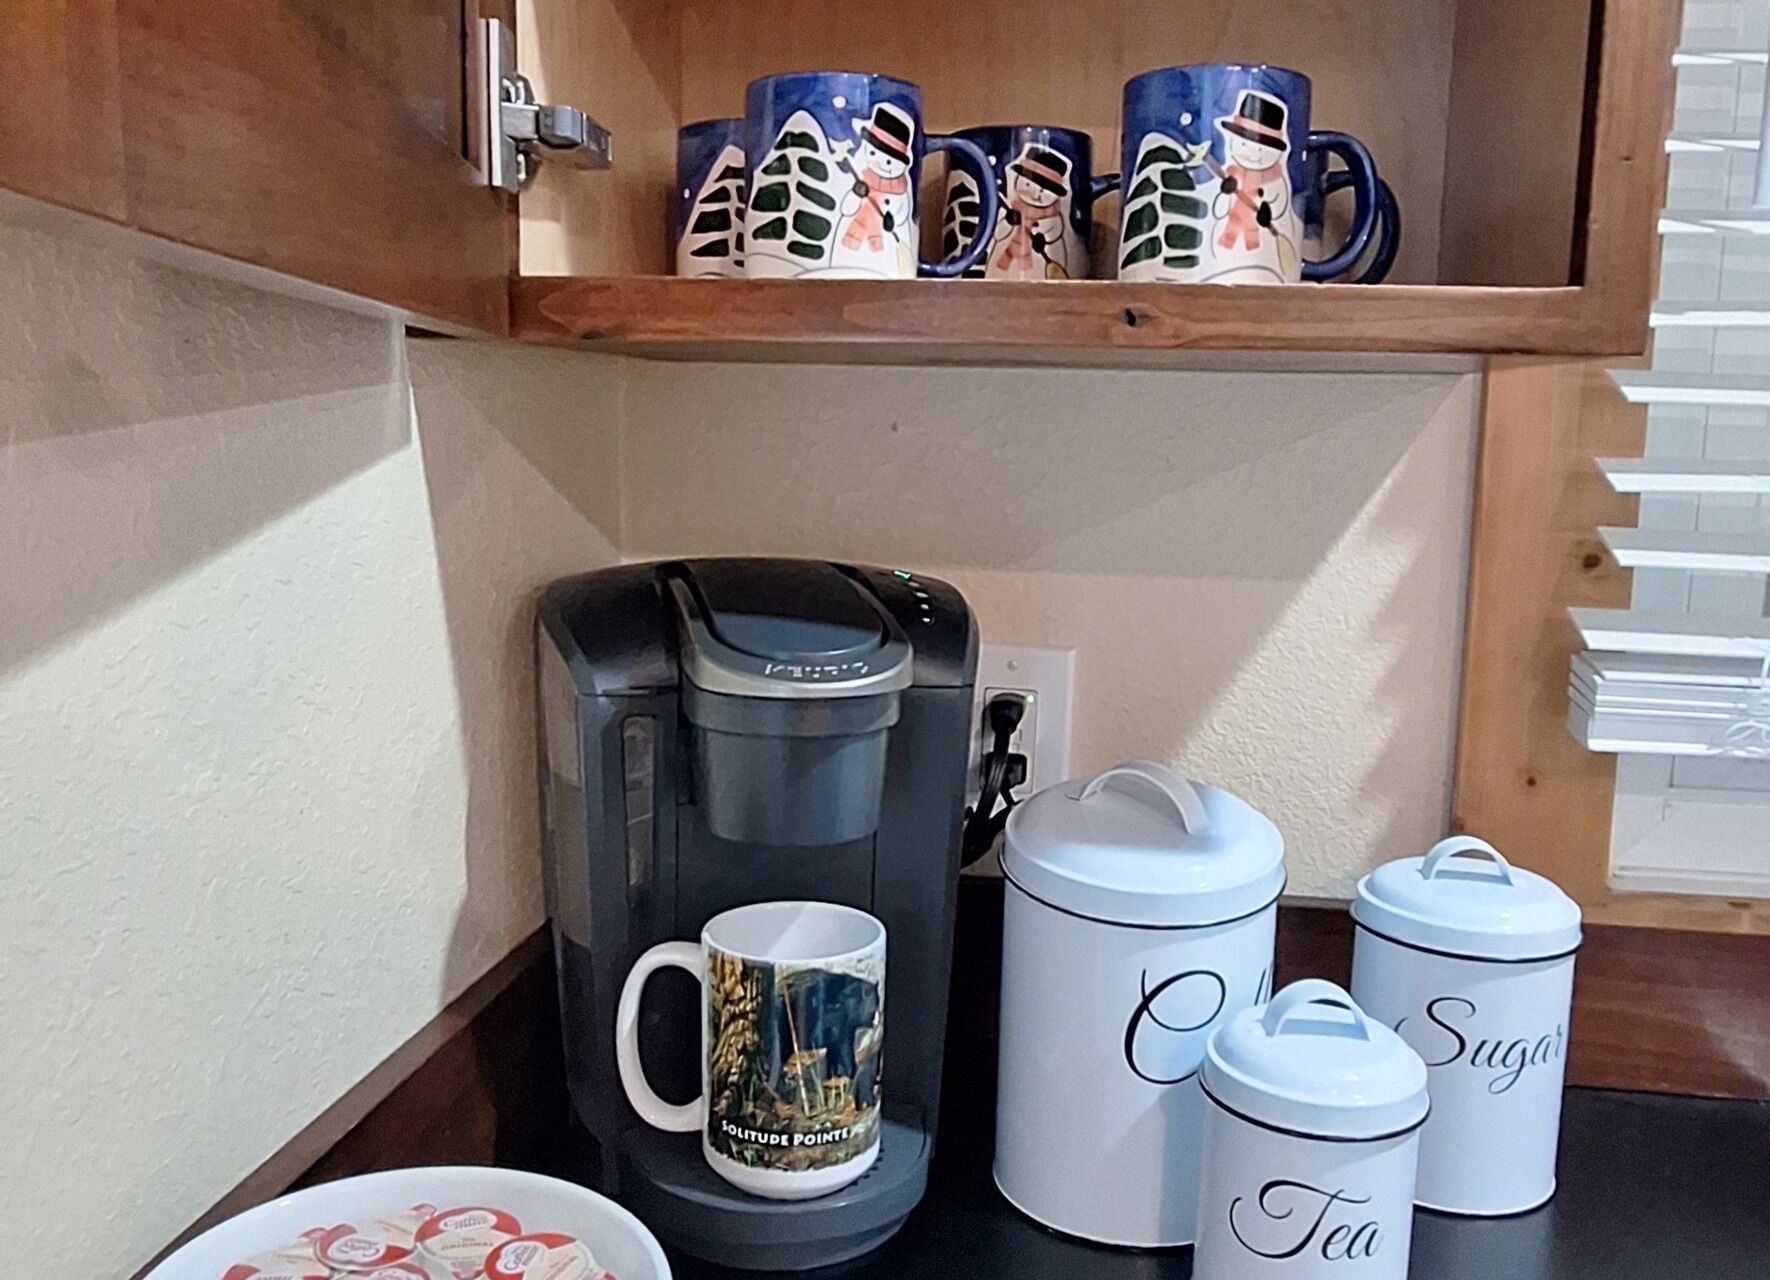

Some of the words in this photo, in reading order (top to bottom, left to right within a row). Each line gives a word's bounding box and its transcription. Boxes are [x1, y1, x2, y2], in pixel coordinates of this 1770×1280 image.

[1394, 996, 1563, 1095] Sugar
[721, 1120, 789, 1147] SOLITUDE
[793, 1126, 850, 1146] POINTE
[1229, 1179, 1384, 1261] Tea
